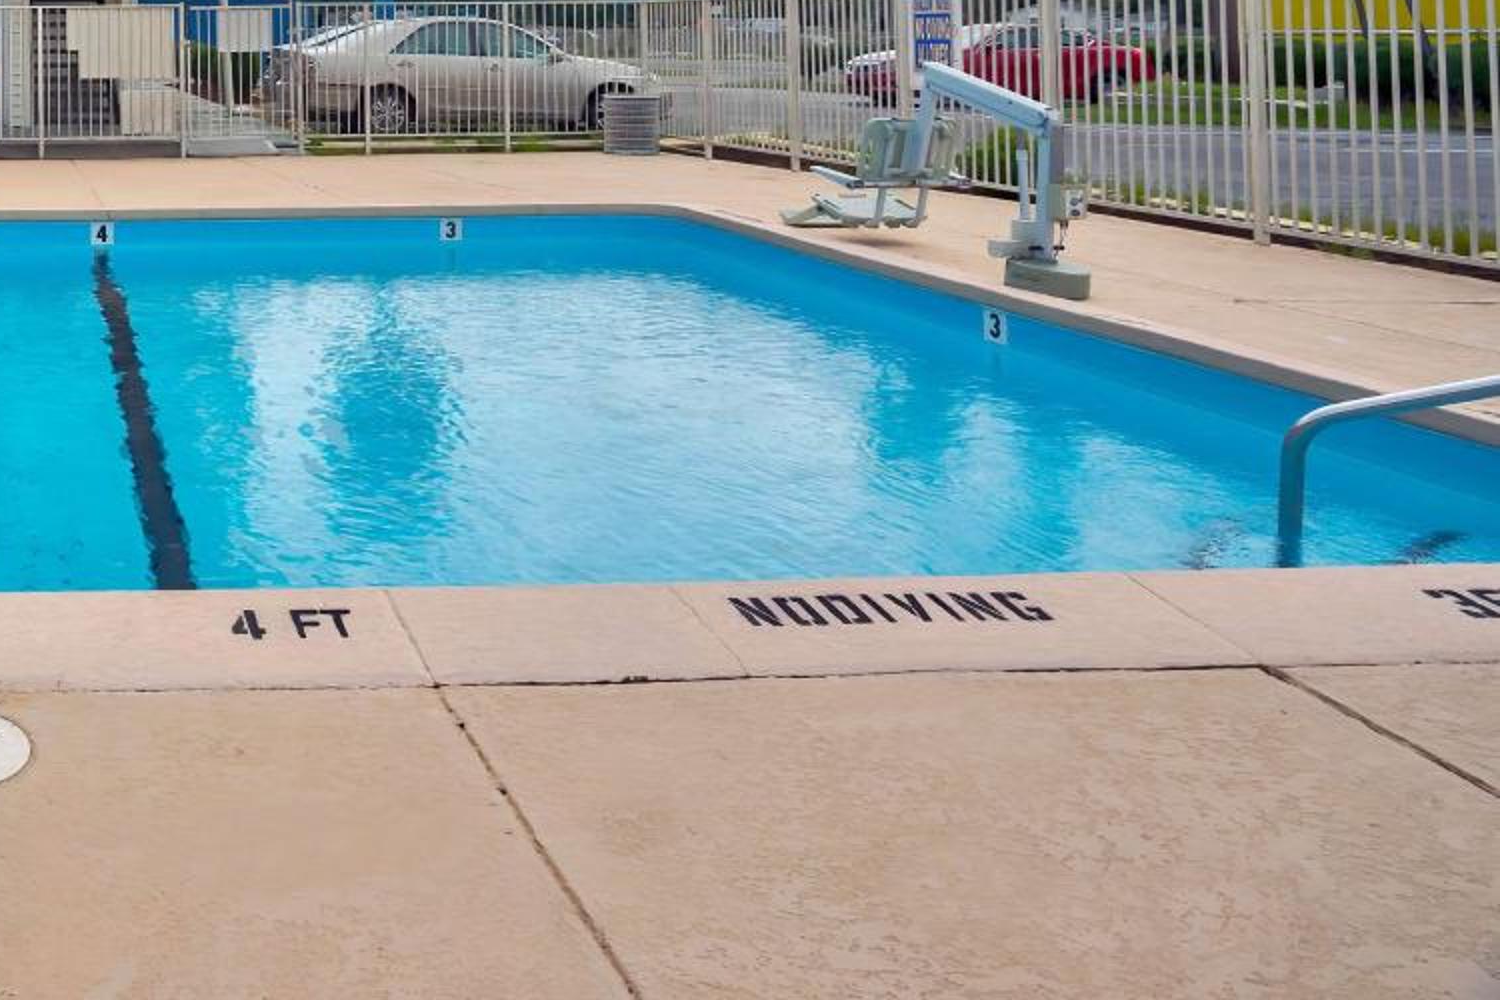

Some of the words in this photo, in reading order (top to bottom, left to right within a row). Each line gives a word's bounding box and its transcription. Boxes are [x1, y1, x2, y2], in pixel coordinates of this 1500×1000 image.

[95, 224, 109, 243] 4
[444, 221, 457, 239] 3
[989, 312, 1001, 339] 3
[231, 609, 267, 640] 4
[289, 608, 351, 639] FT
